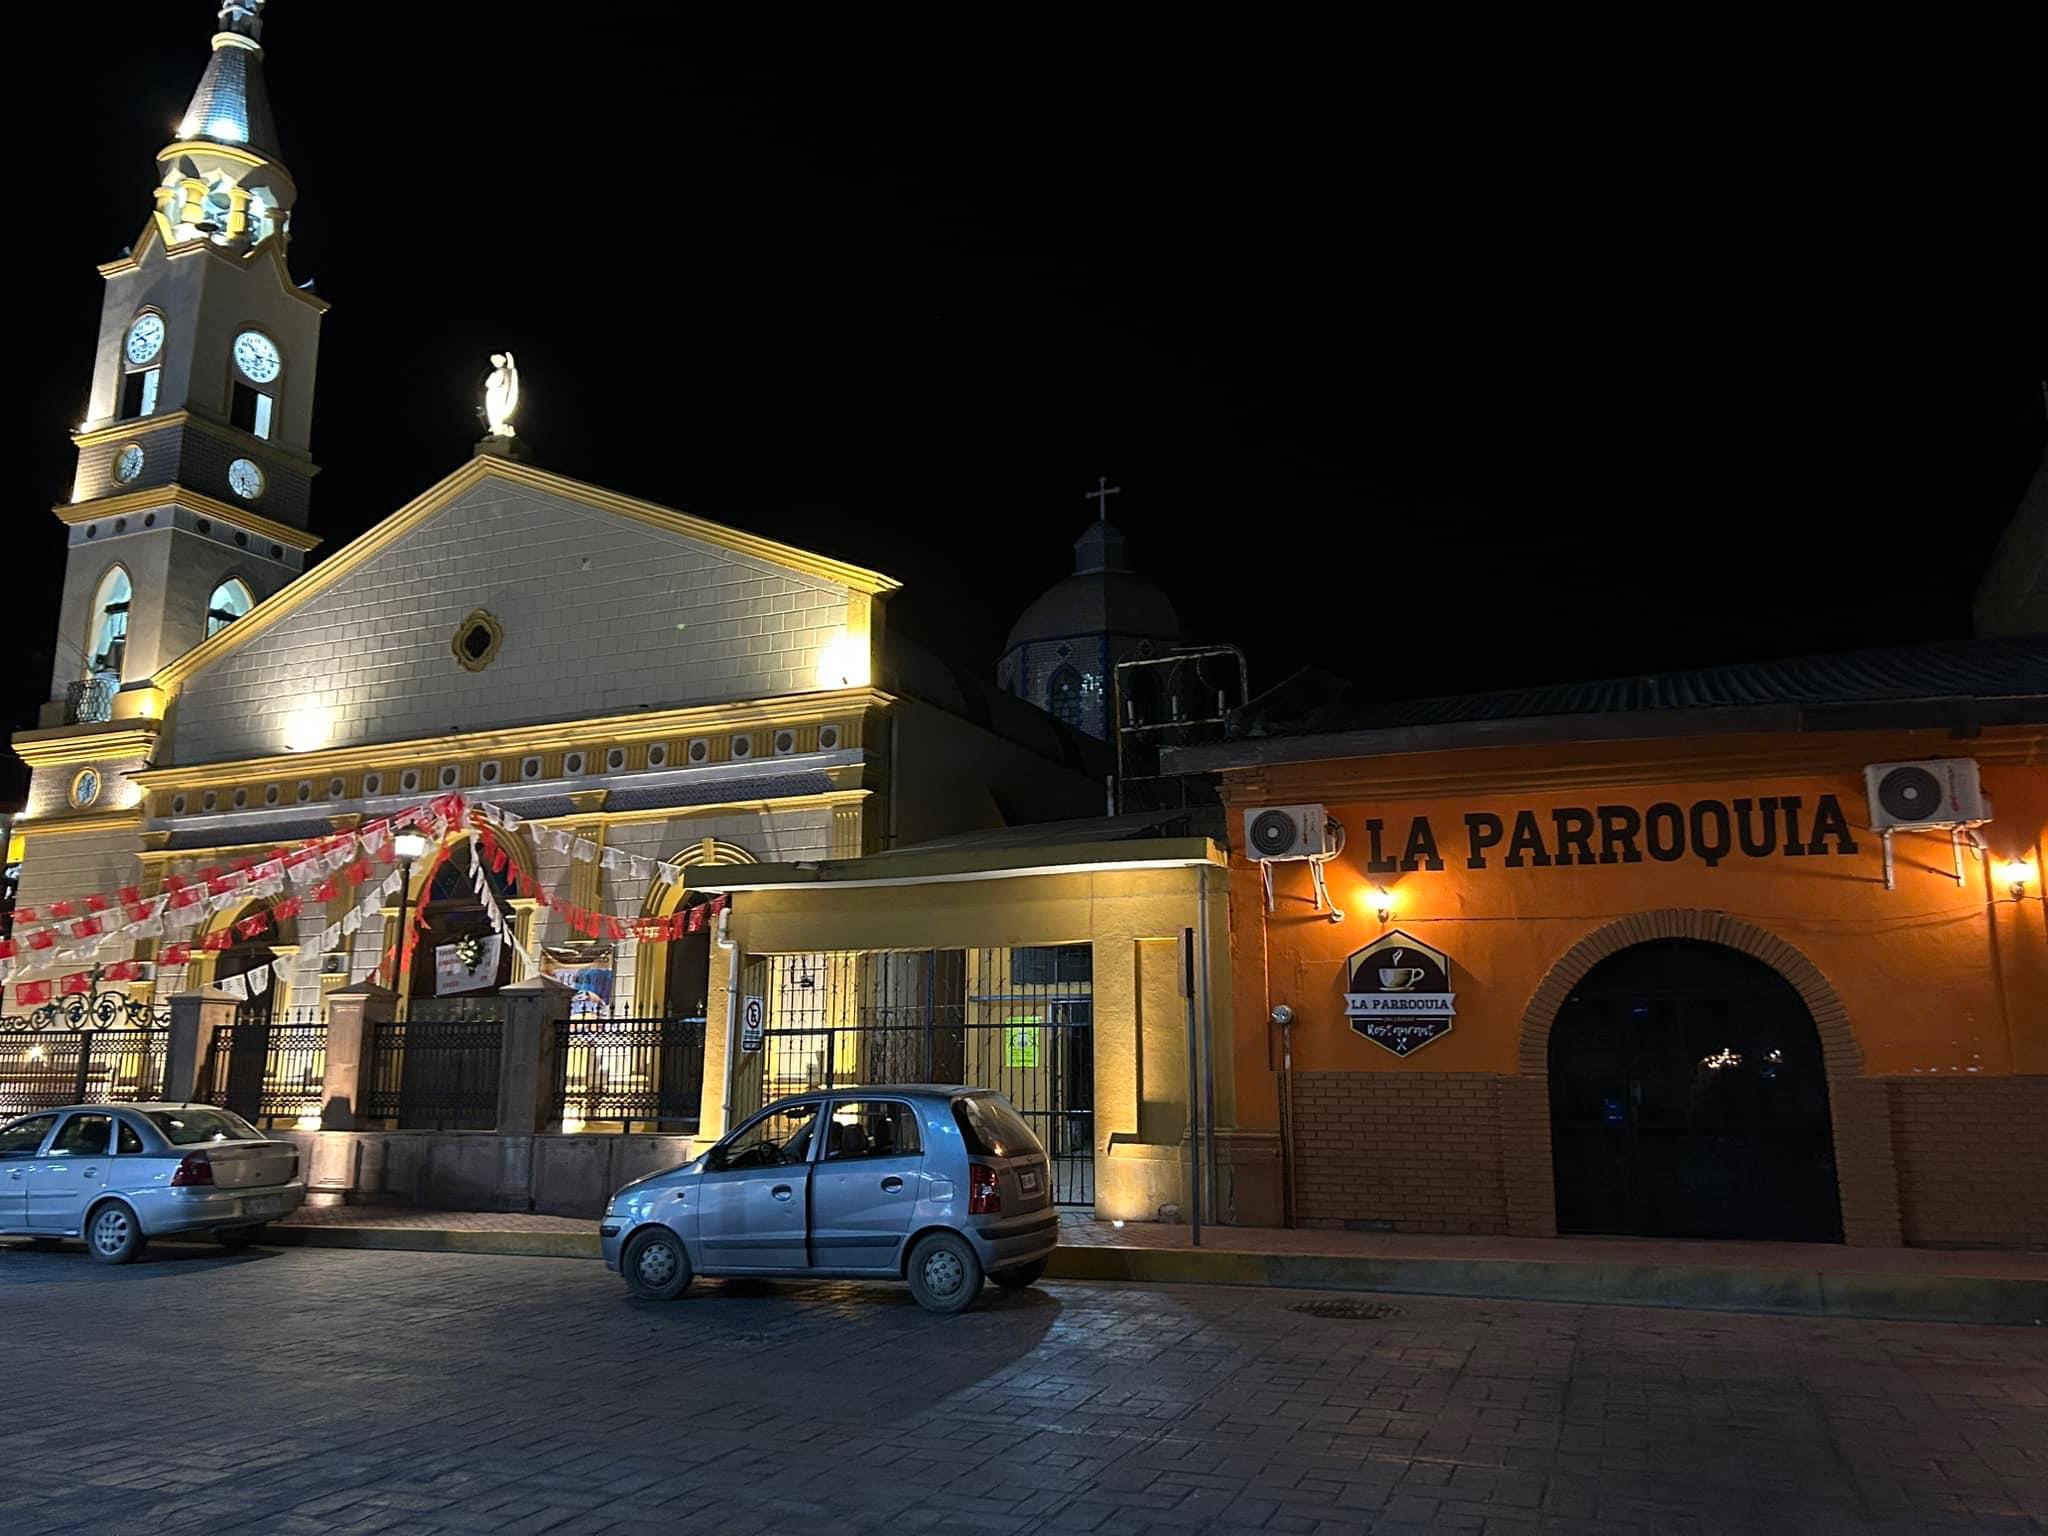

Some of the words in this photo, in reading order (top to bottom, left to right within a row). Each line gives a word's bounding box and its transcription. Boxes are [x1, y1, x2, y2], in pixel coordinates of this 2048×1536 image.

[1366, 816, 1444, 873] LA
[1464, 794, 1858, 869] PARROQUIA
[1351, 999, 1368, 1009] LA
[1373, 999, 1448, 1010] PARROQUIA
